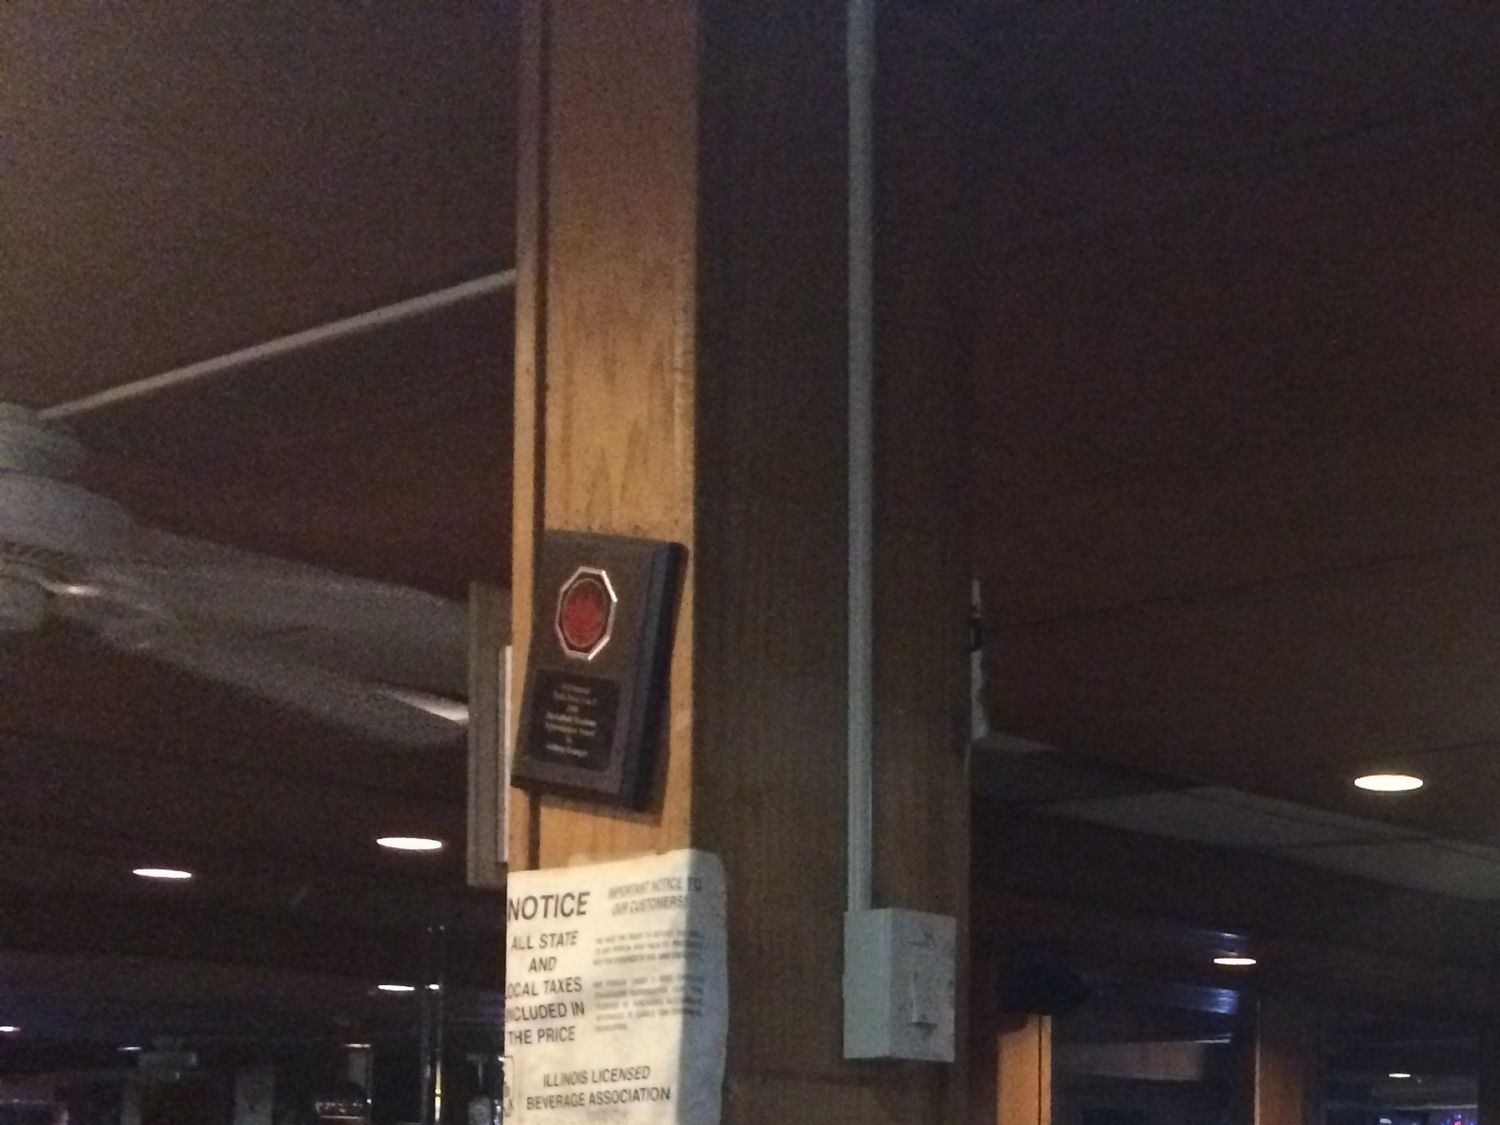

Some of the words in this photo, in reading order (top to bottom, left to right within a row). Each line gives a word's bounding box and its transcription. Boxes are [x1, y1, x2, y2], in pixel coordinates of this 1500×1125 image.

[507, 891, 590, 922] NOTICE
[511, 936, 534, 950] ALL
[538, 930, 579, 947] STATE
[528, 957, 557, 972] AND
[505, 980, 538, 999] OCAL
[543, 976, 583, 994] TAXES
[505, 1003, 567, 1021] NCLUDED
[572, 1001, 585, 1015] IN
[508, 1029, 533, 1044] THE
[537, 1026, 576, 1042] PRICE
[543, 1069, 588, 1088] ILLINOIS
[591, 1065, 651, 1083] LICENSED
[526, 1092, 585, 1111] BEVERAGE
[588, 1086, 671, 1106] ASSOCIATION
